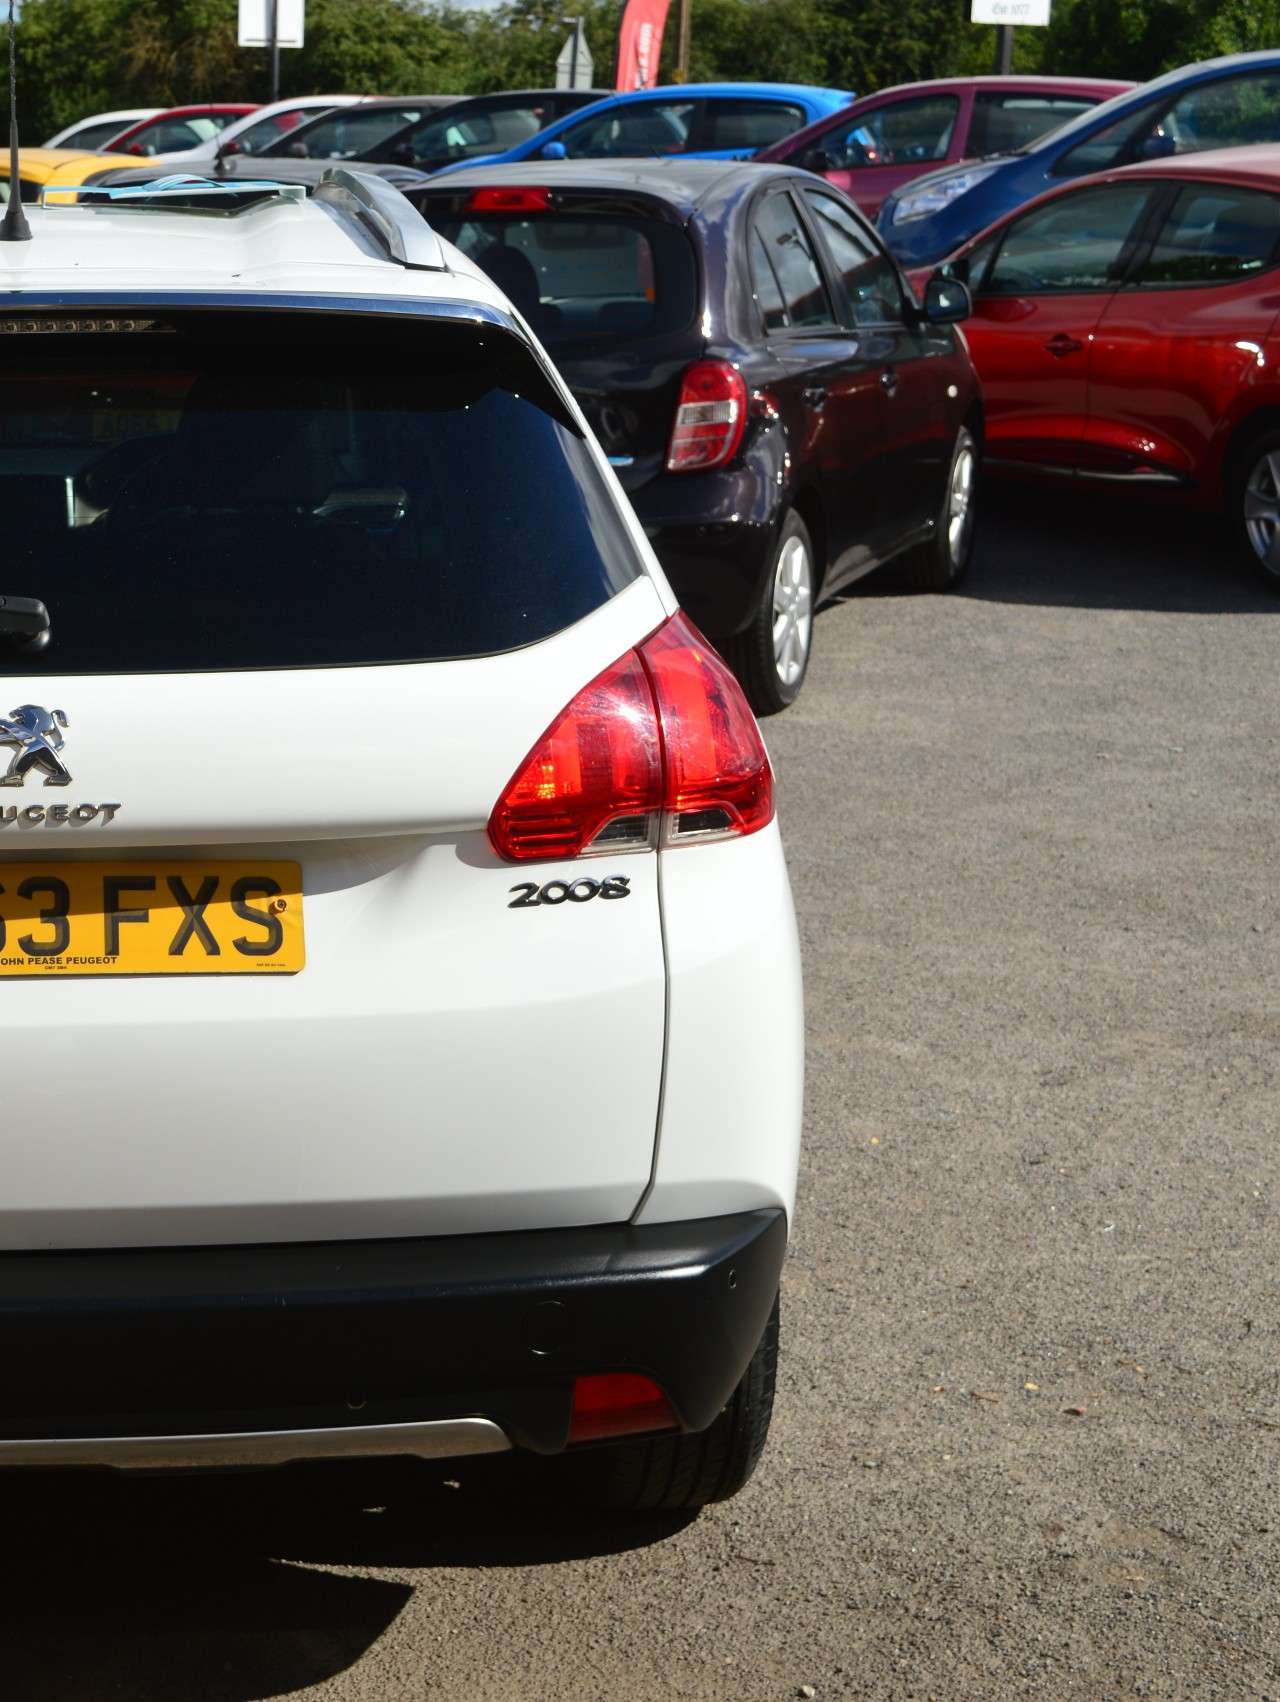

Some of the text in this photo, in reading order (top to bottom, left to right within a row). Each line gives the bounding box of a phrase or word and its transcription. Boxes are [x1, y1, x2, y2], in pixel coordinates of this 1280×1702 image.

[507, 874, 631, 908] 2008
[103, 875, 284, 957] FXS
[28, 957, 62, 965] PEASE
[66, 956, 118, 965] PEUGEOT
